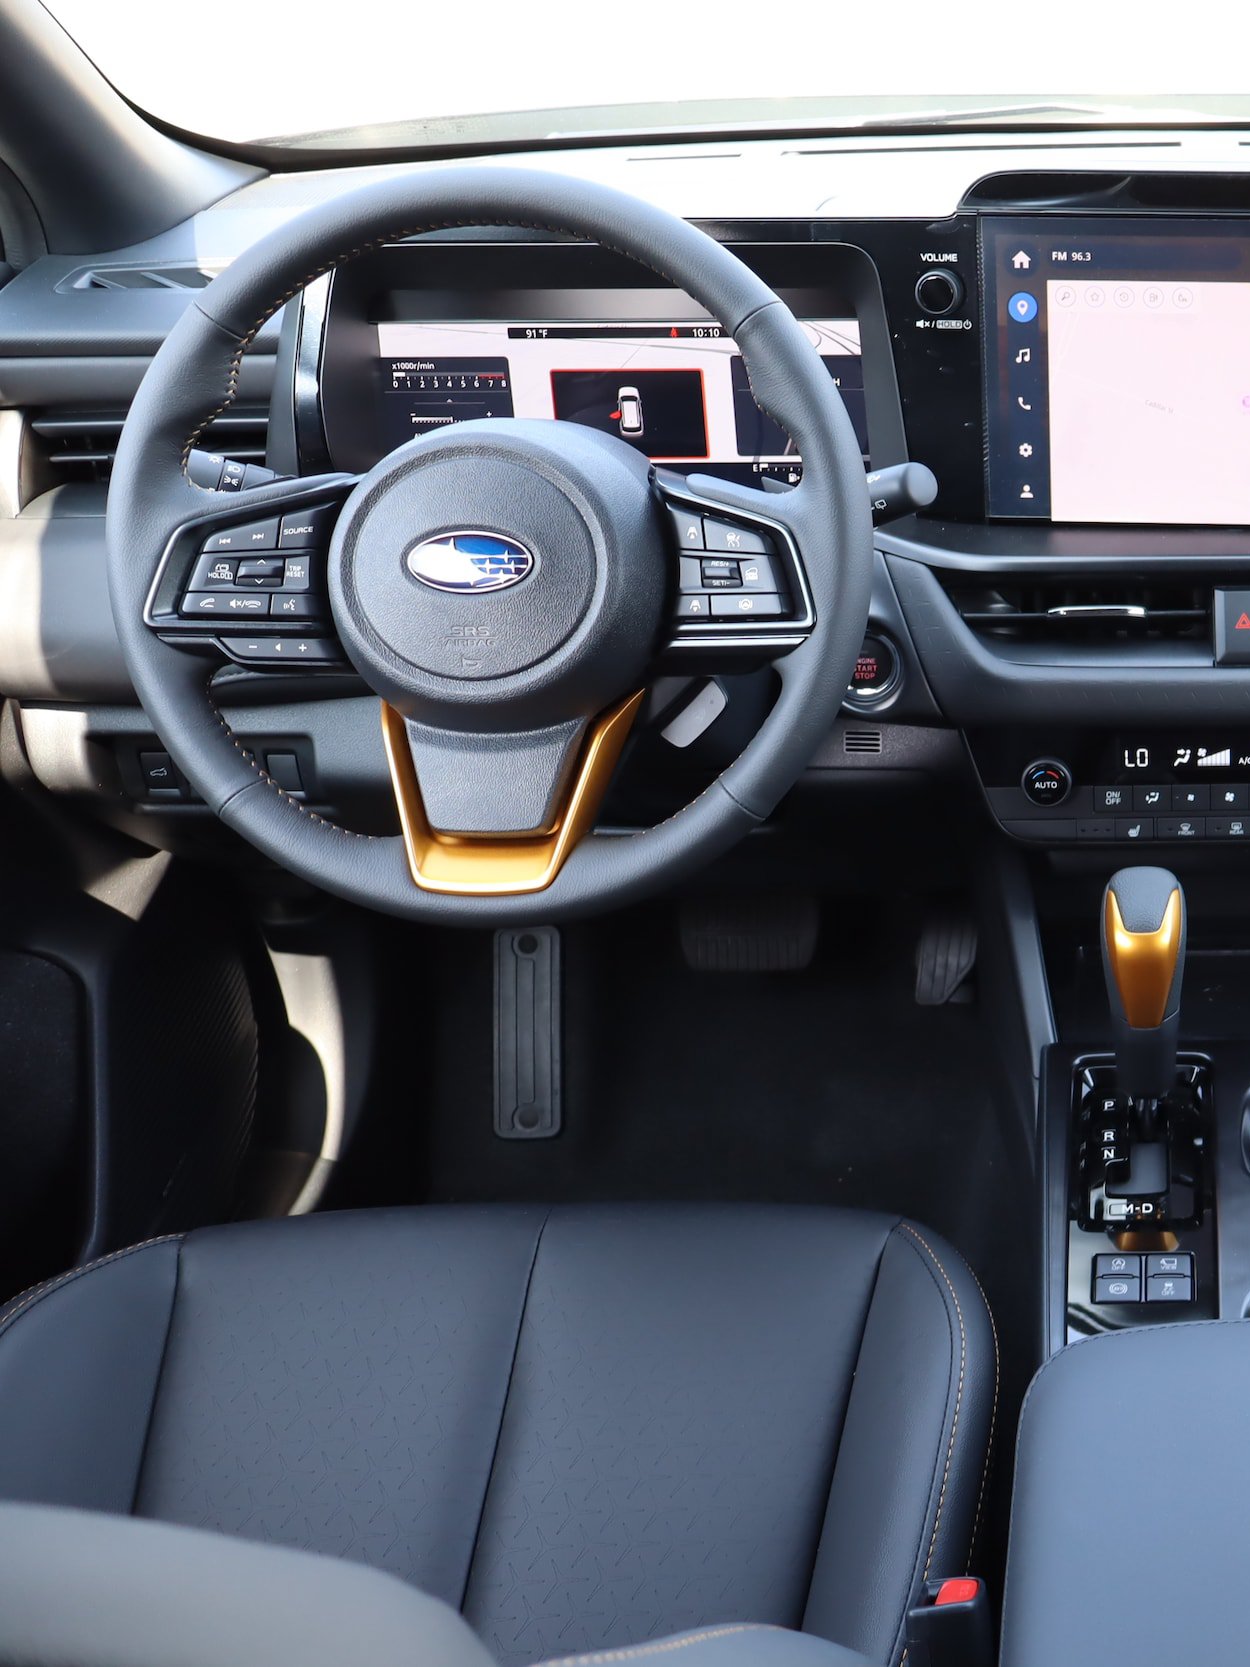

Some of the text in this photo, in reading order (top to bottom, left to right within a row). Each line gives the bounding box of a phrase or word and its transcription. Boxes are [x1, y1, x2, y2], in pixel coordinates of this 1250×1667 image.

[920, 253, 958, 262] VOLUME
[1052, 251, 1091, 261] FM 96.3
[937, 320, 963, 329] HOLD
[692, 328, 720, 338] 10:10
[392, 361, 435, 371] x1000r/min
[392, 380, 507, 388] 0 1 2 3 4 5 6 7 8
[752, 464, 758, 472] E
[283, 526, 314, 536] SOURCE
[450, 625, 490, 636] SRS
[445, 639, 496, 647] AIRBAG
[855, 672, 876, 680] STOP
[1034, 781, 1058, 789] AUTO
[1105, 791, 1121, 799] ON/
[1104, 1100, 1114, 1111] P
[1104, 1131, 1114, 1141] R
[1103, 1149, 1114, 1159] N
